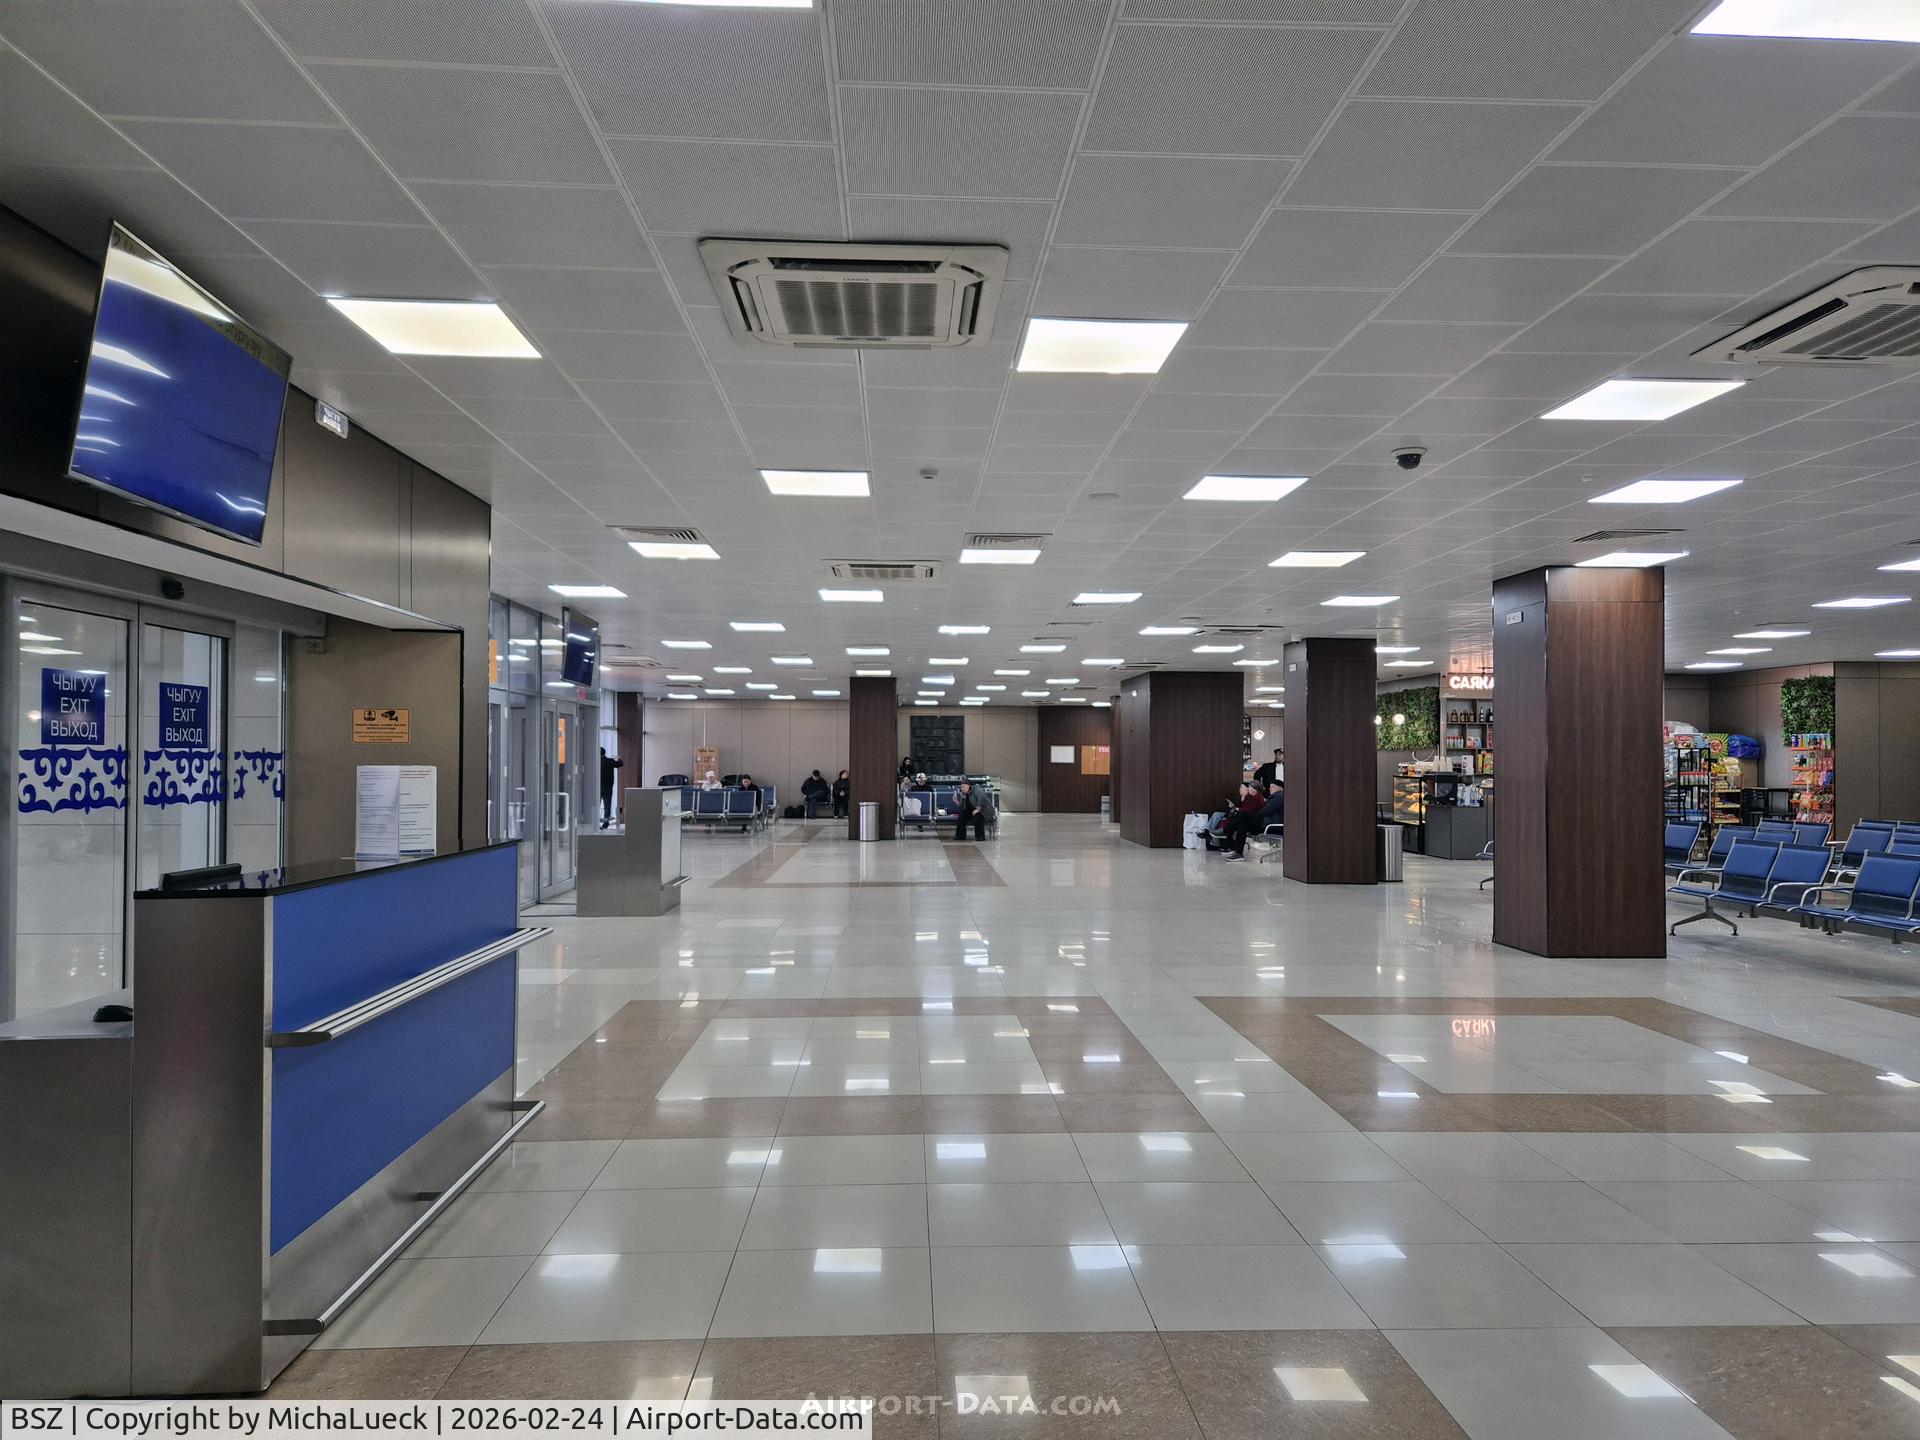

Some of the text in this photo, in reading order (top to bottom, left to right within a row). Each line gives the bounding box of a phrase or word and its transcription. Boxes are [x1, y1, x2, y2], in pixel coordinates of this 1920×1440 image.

[52, 673, 97, 694] ЧЫГУУ
[166, 687, 202, 704] ЧЫГУУ
[60, 697, 90, 714] EXIT
[173, 707, 196, 722] EXIT
[51, 720, 98, 741] ВЫХОД
[165, 727, 203, 745] ВЫХОД
